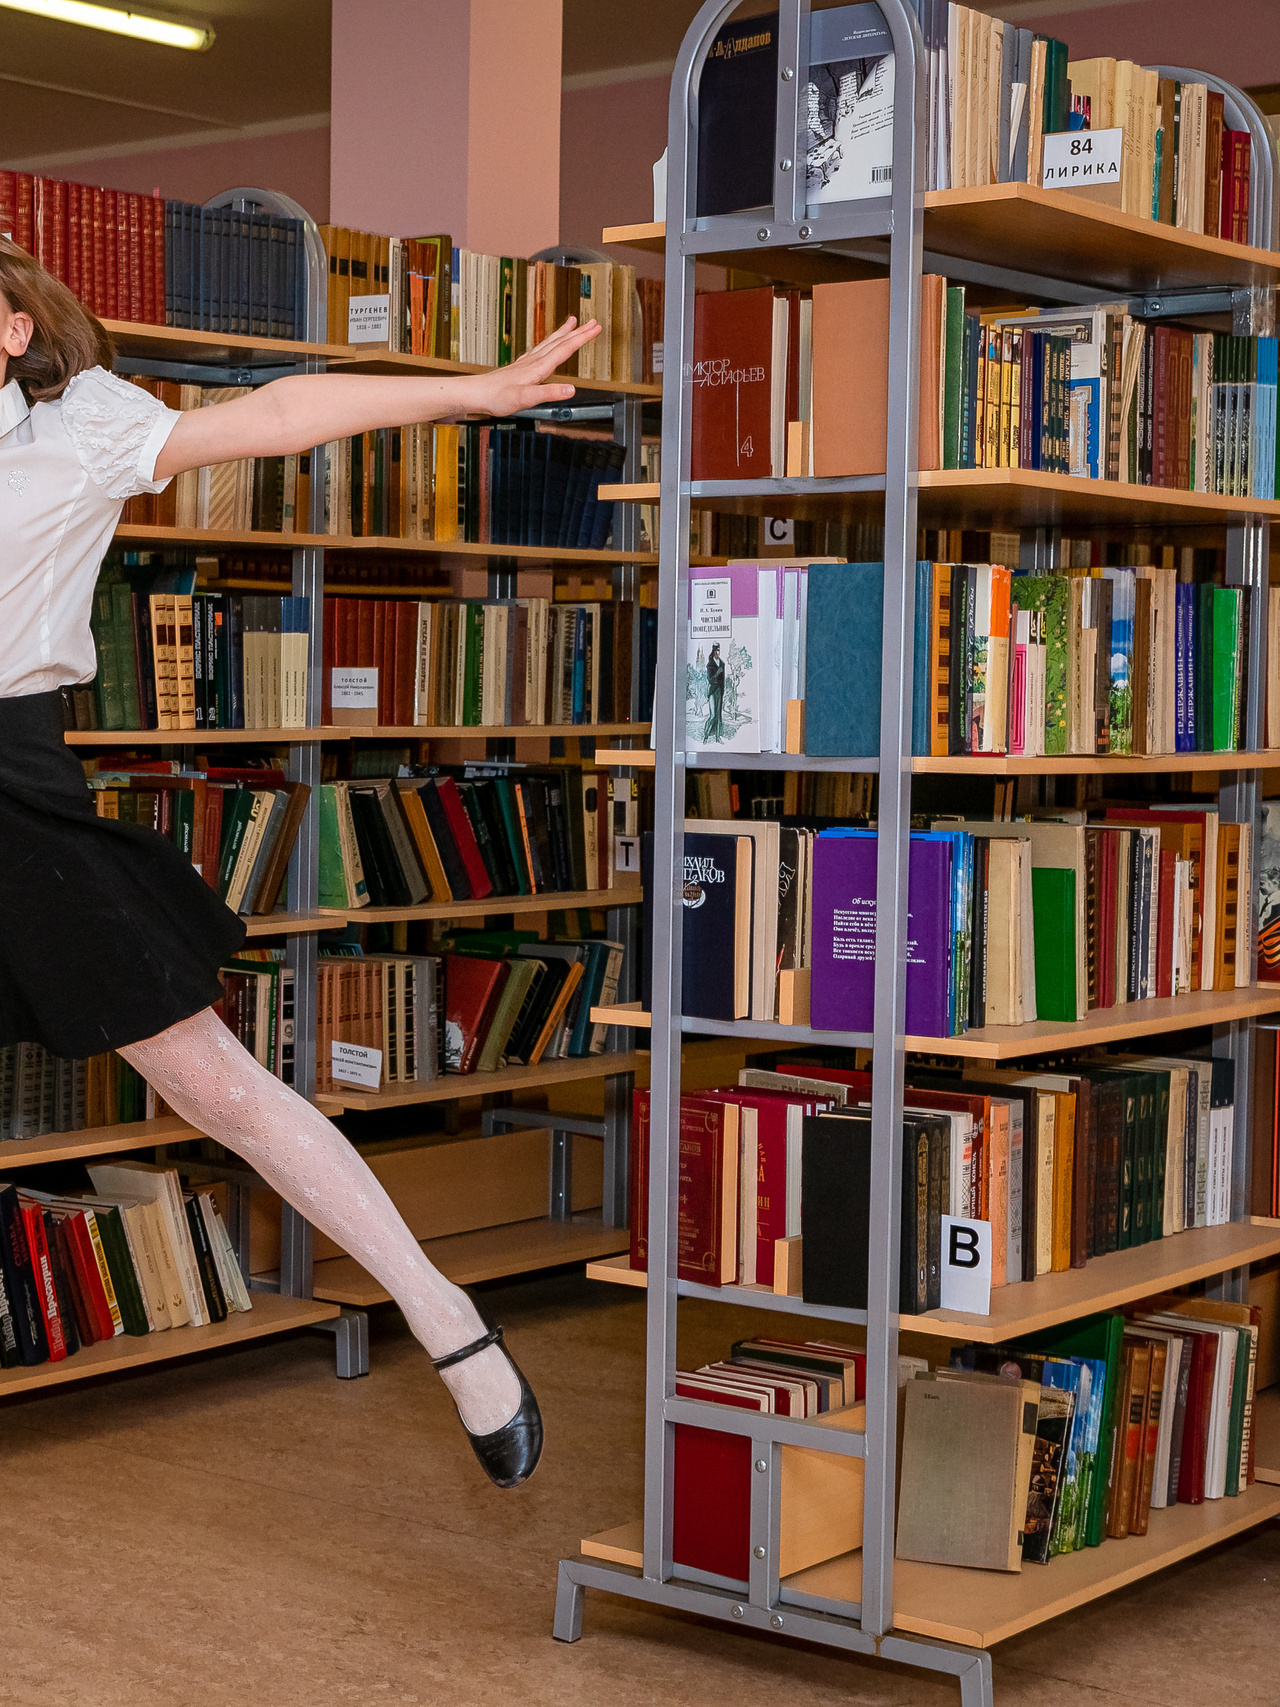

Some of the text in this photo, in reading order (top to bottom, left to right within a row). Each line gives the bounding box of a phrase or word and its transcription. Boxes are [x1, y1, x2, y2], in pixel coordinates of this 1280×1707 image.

[1069, 137, 1093, 156] 84
[1044, 161, 1118, 180] ЛИРИКА
[349, 306, 388, 315] ТУРГЕНЕВ
[700, 367, 765, 387] АСТАФЬЕВ
[740, 435, 754, 457] 4
[769, 517, 788, 541] С
[692, 625, 730, 633] ПОНЕДЕЛЬНИК
[700, 615, 722, 624] ЧИСТЫЙ
[196, 707, 203, 721] 1
[209, 707, 216, 721] 2
[620, 841, 635, 867] Т
[339, 1047, 368, 1058] ТОЛСТОЙ
[949, 1224, 981, 1269] В
